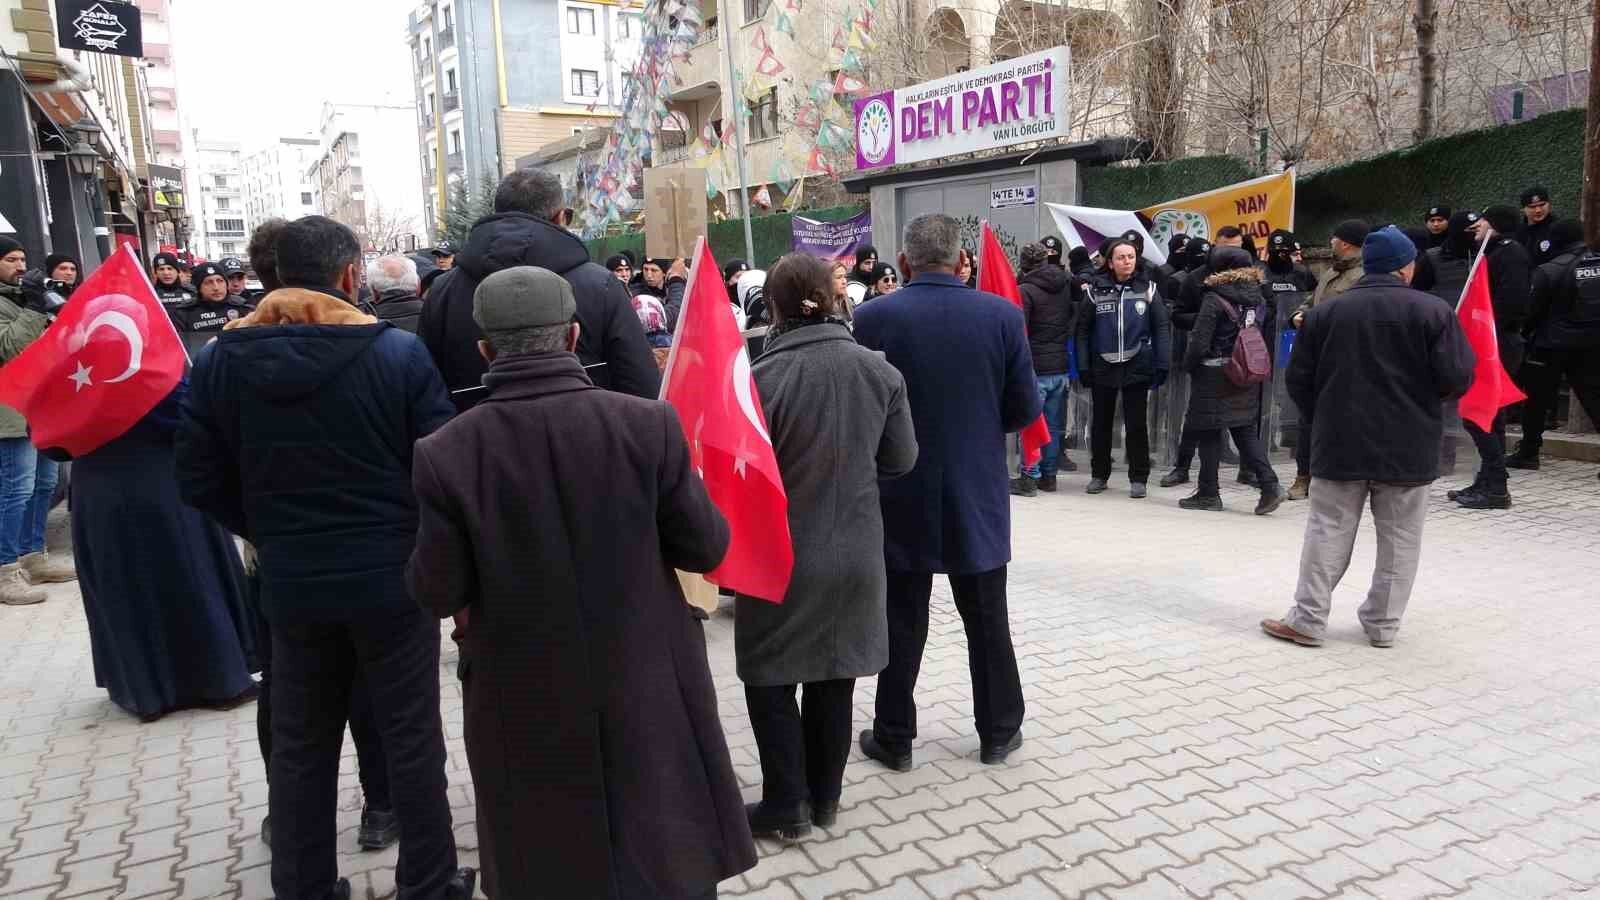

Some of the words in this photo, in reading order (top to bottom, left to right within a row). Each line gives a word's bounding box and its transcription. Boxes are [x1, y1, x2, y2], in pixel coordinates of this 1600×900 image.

[905, 90, 939, 105] HALKLARIN
[940, 81, 964, 96] EŞİTLİK
[965, 79, 975, 90] VE
[975, 67, 1015, 88] DEMOKRASİ
[902, 96, 952, 143] DEM
[962, 58, 1052, 131] PARTİ
[993, 128, 1010, 141] VAN
[1020, 119, 1055, 136] ÖRGÜTÜ
[1015, 187, 1024, 198] 14
[1234, 193, 1267, 216] NAN
